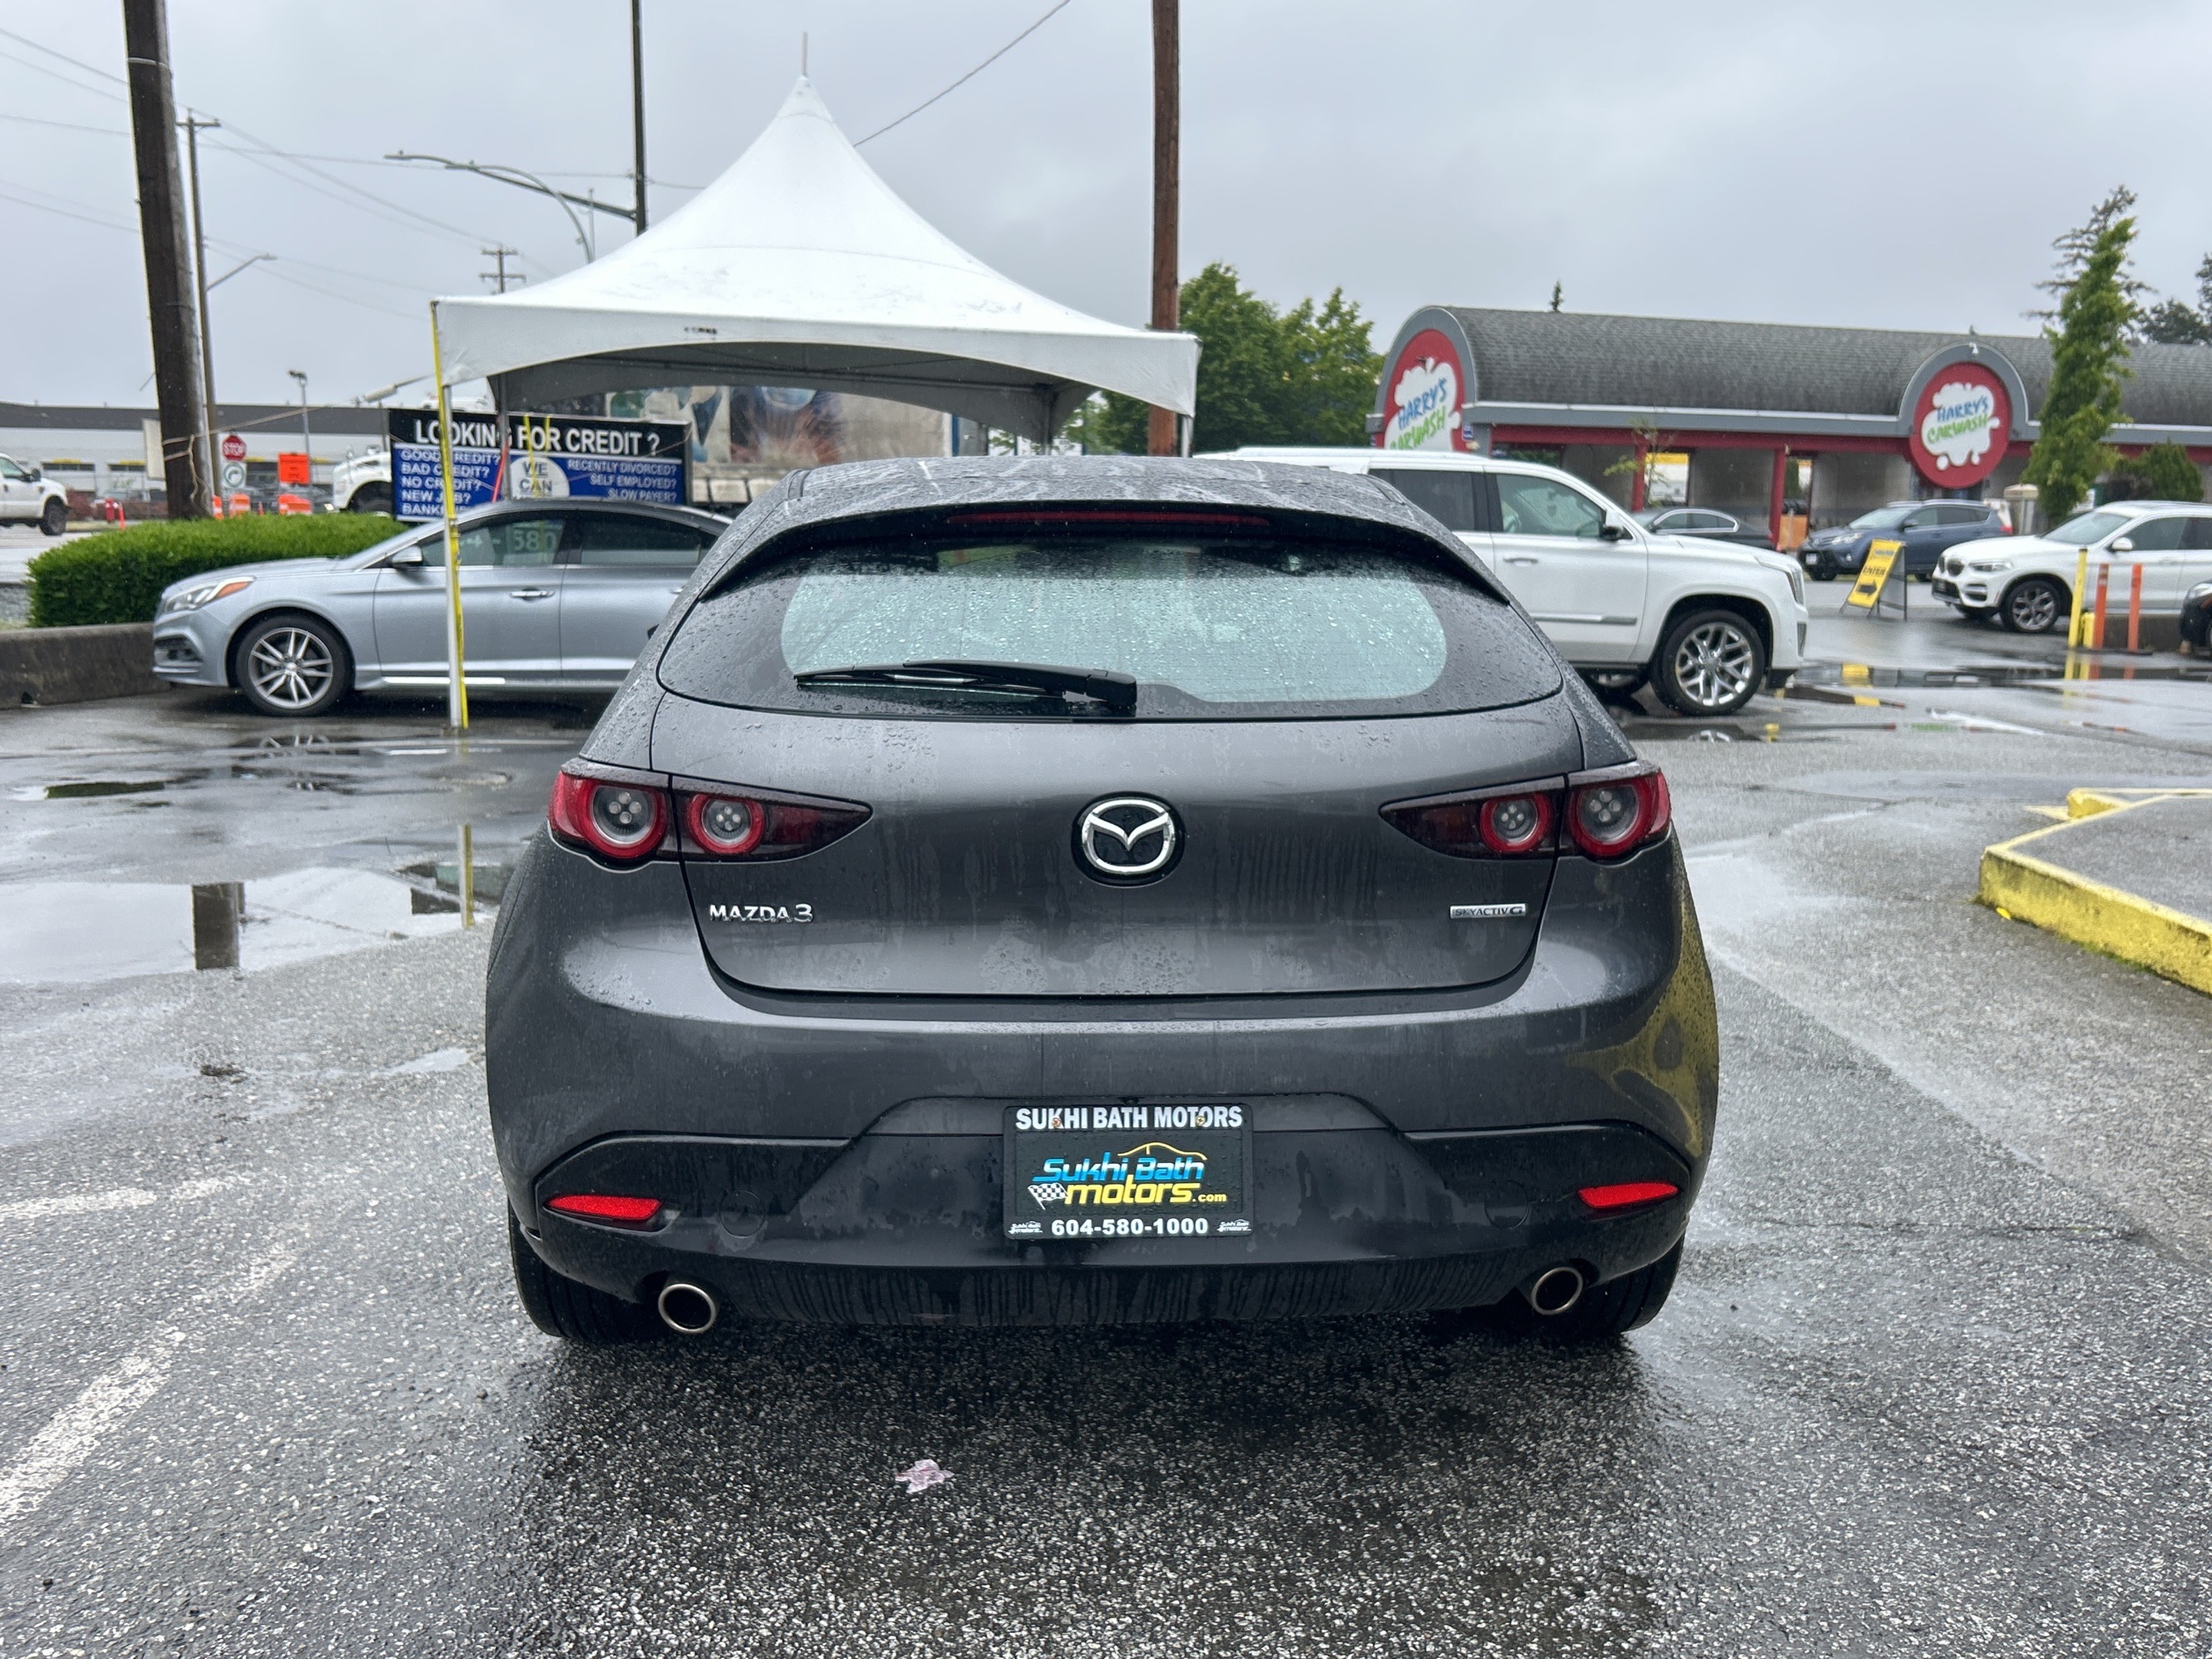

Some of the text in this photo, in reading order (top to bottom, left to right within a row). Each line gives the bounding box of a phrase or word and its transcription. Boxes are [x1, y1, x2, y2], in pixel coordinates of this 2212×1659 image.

[1926, 412, 1988, 443] CARWASH
[517, 425, 561, 452] FOR
[565, 427, 642, 455] CREDIT
[224, 442, 245, 456] STOP
[453, 452, 501, 465] REDIT?
[401, 462, 490, 478] BAD CEDIT?
[522, 461, 548, 476] WE
[567, 459, 677, 475] RECENTLY DIVORCED?
[401, 476, 482, 492] NO CRDIT?
[519, 478, 553, 492] CAN
[590, 473, 677, 488] SELF EMPLOYED?
[401, 489, 472, 505] NEW JB?
[608, 488, 677, 504] SLOW PAYER?
[1863, 565, 1886, 577] ENTER
[1015, 1105, 1243, 1130] SUKHI BATH MOTORS
[1032, 1152, 1205, 1182] Sukhi Bath
[1051, 1217, 1210, 1236] 604-580-1000
